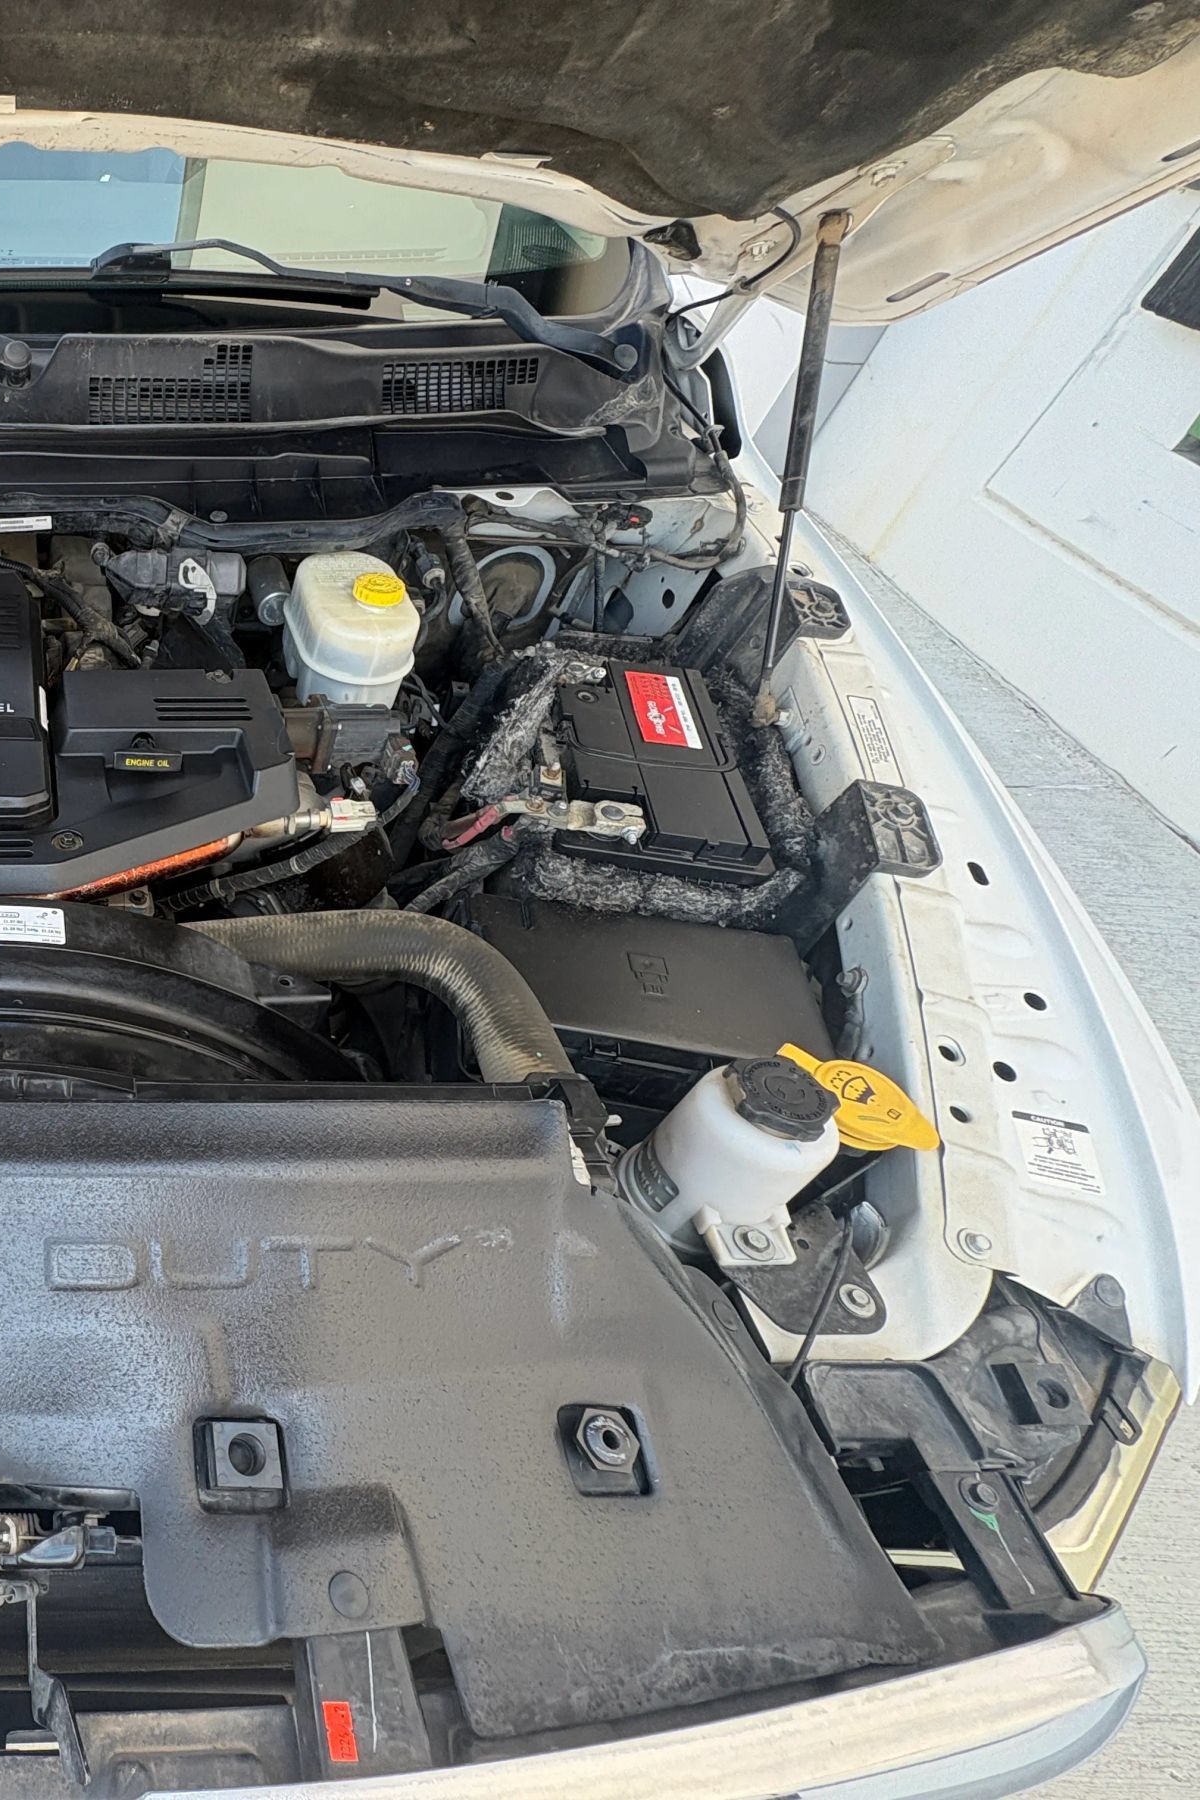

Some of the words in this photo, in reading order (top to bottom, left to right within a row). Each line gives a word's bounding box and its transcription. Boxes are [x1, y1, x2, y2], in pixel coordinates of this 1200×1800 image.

[125, 758, 155, 767] ENGINE
[157, 759, 170, 768] OIL
[43, 1234, 462, 1290] DUTY
